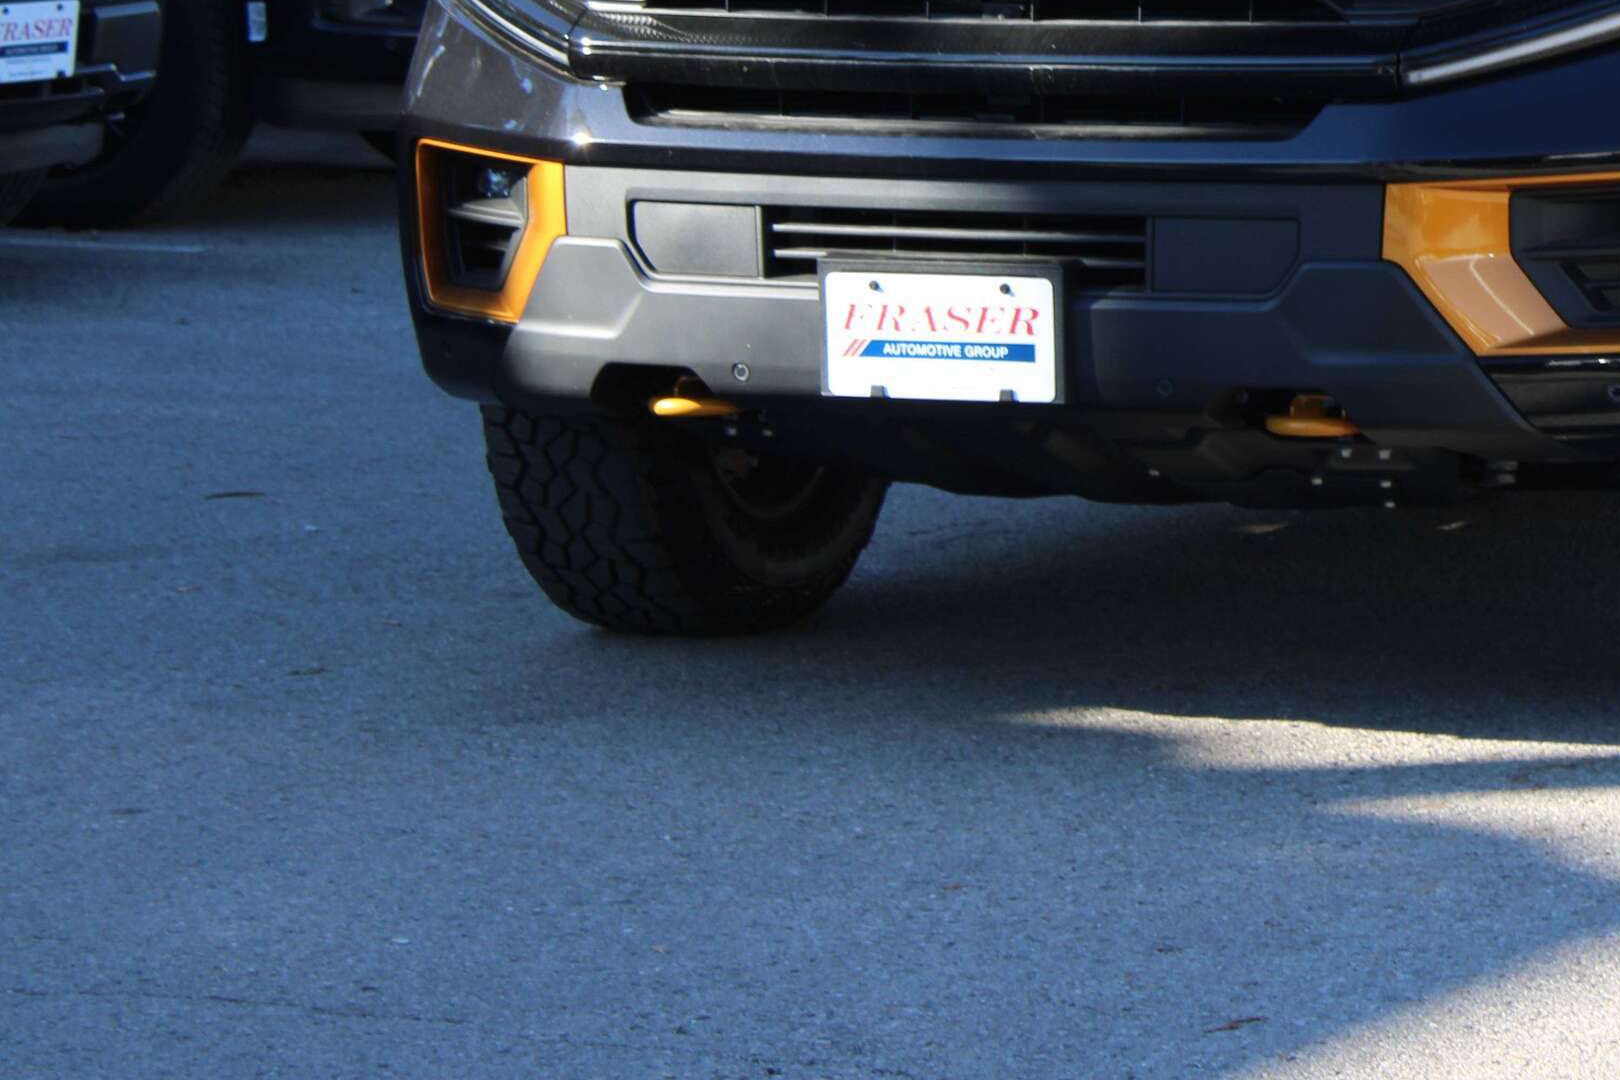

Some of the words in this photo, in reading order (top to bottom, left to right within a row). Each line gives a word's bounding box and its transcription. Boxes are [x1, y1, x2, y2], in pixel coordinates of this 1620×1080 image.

[0, 17, 73, 41] RASER
[843, 303, 1040, 336] FRASER
[883, 342, 962, 358] AUTOMOTIVE
[964, 345, 1009, 359] GROUP
